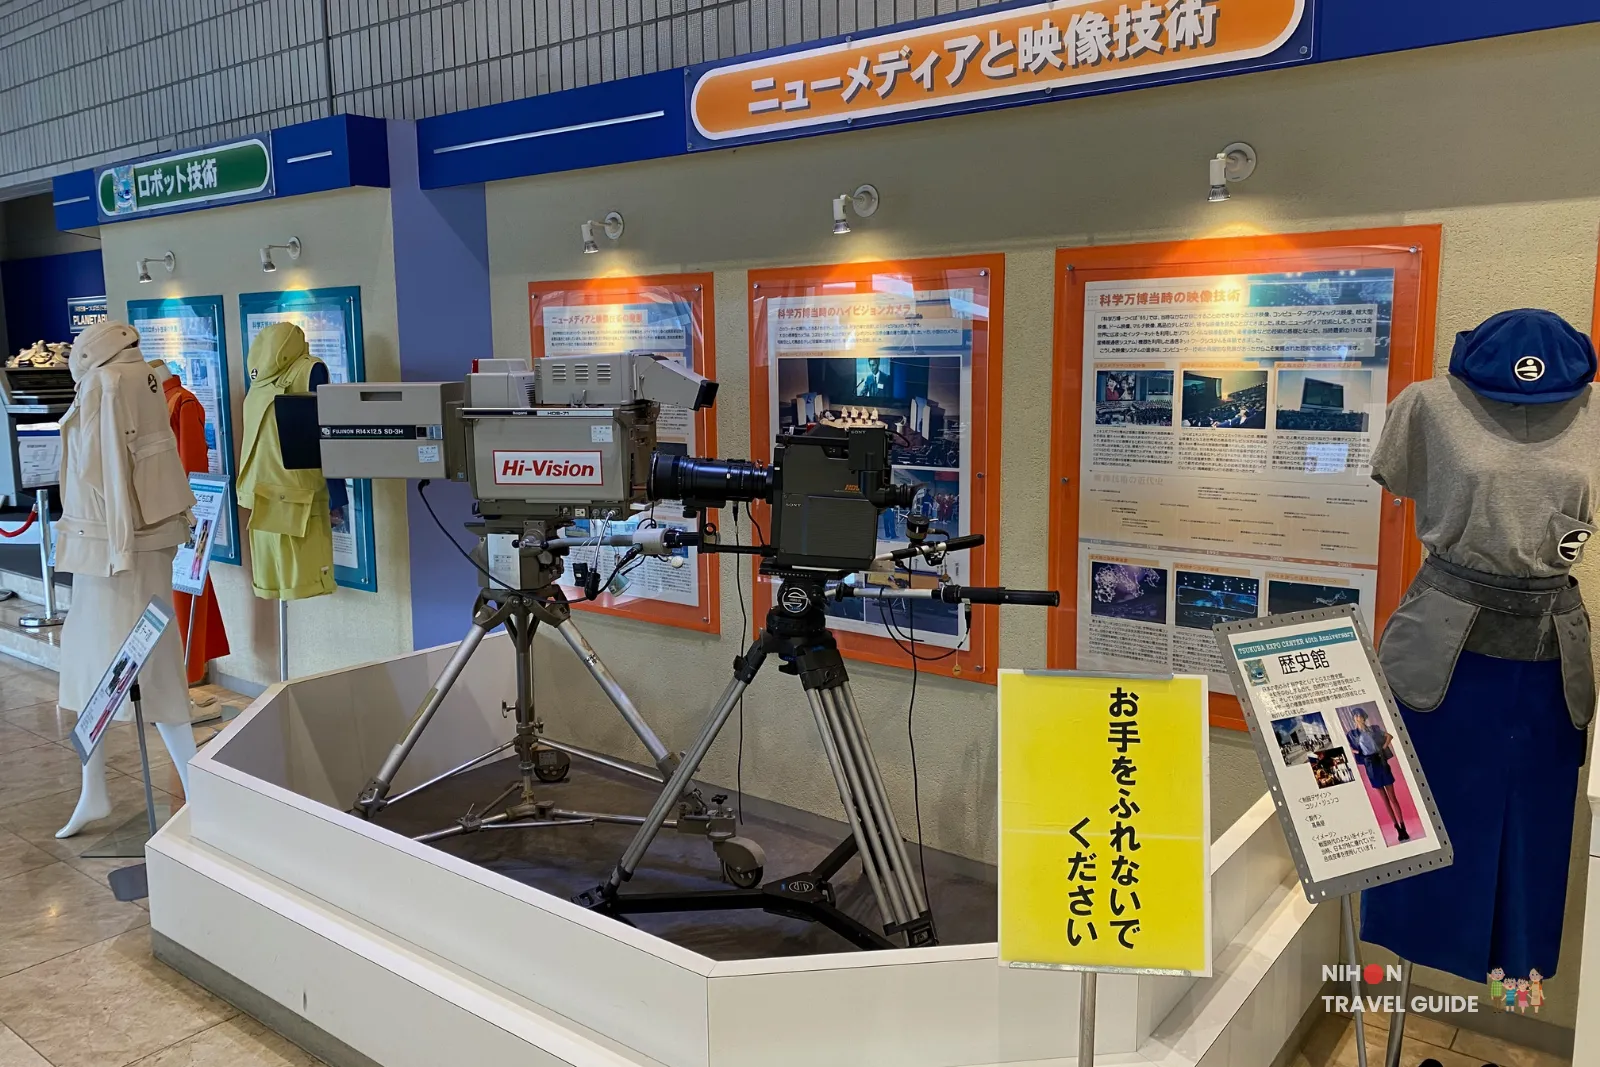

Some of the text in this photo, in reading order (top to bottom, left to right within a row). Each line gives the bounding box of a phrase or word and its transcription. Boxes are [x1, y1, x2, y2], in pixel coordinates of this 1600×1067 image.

[749, 0, 1218, 112] ニューメディアと映像技術
[138, 158, 217, 198] ロボット技術
[1100, 289, 1240, 306] 科学万博当時の映像技術
[777, 304, 911, 319] 科学万博当時のハイビジョンカメラ
[502, 459, 595, 477] Hi-Vision
[1238, 631, 1354, 655] TSUKUBA EXPO CENTER 40th Anniversary
[1278, 648, 1330, 675] 歴史館
[1107, 687, 1141, 949] お手をふれないで
[1067, 817, 1098, 947] ください
